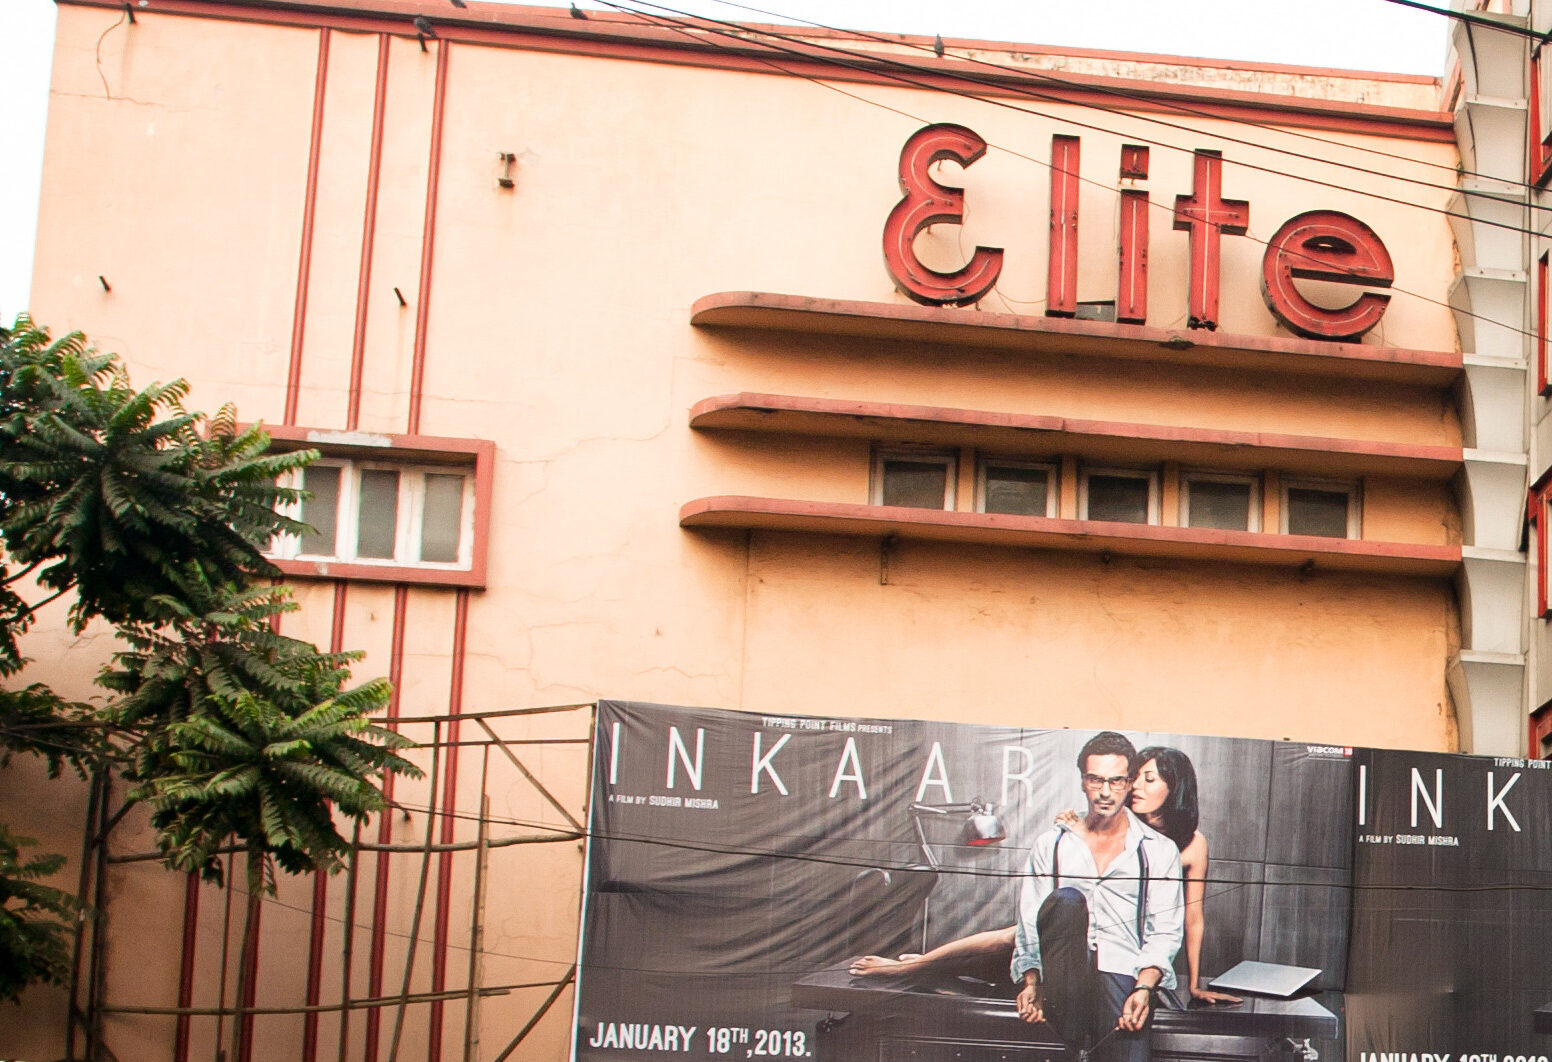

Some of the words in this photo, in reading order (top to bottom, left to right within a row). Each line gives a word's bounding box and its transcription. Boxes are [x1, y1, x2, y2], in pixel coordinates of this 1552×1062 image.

[883, 122, 1394, 342] Elite
[801, 719, 827, 731] POINT
[829, 720, 857, 732] FILMS
[609, 722, 1034, 808] INKAAR
[608, 794, 614, 803] A
[616, 794, 634, 804] FILM
[635, 796, 647, 805] BY
[648, 795, 682, 807] SUDHIR
[684, 797, 719, 810] MISHRA
[1358, 835, 1364, 843] A
[1366, 834, 1382, 844] FILM
[1383, 836, 1394, 844] BY
[1395, 833, 1425, 845] SUDHIR
[1427, 836, 1459, 847] MISHRA
[590, 1022, 697, 1051] JANUARY
